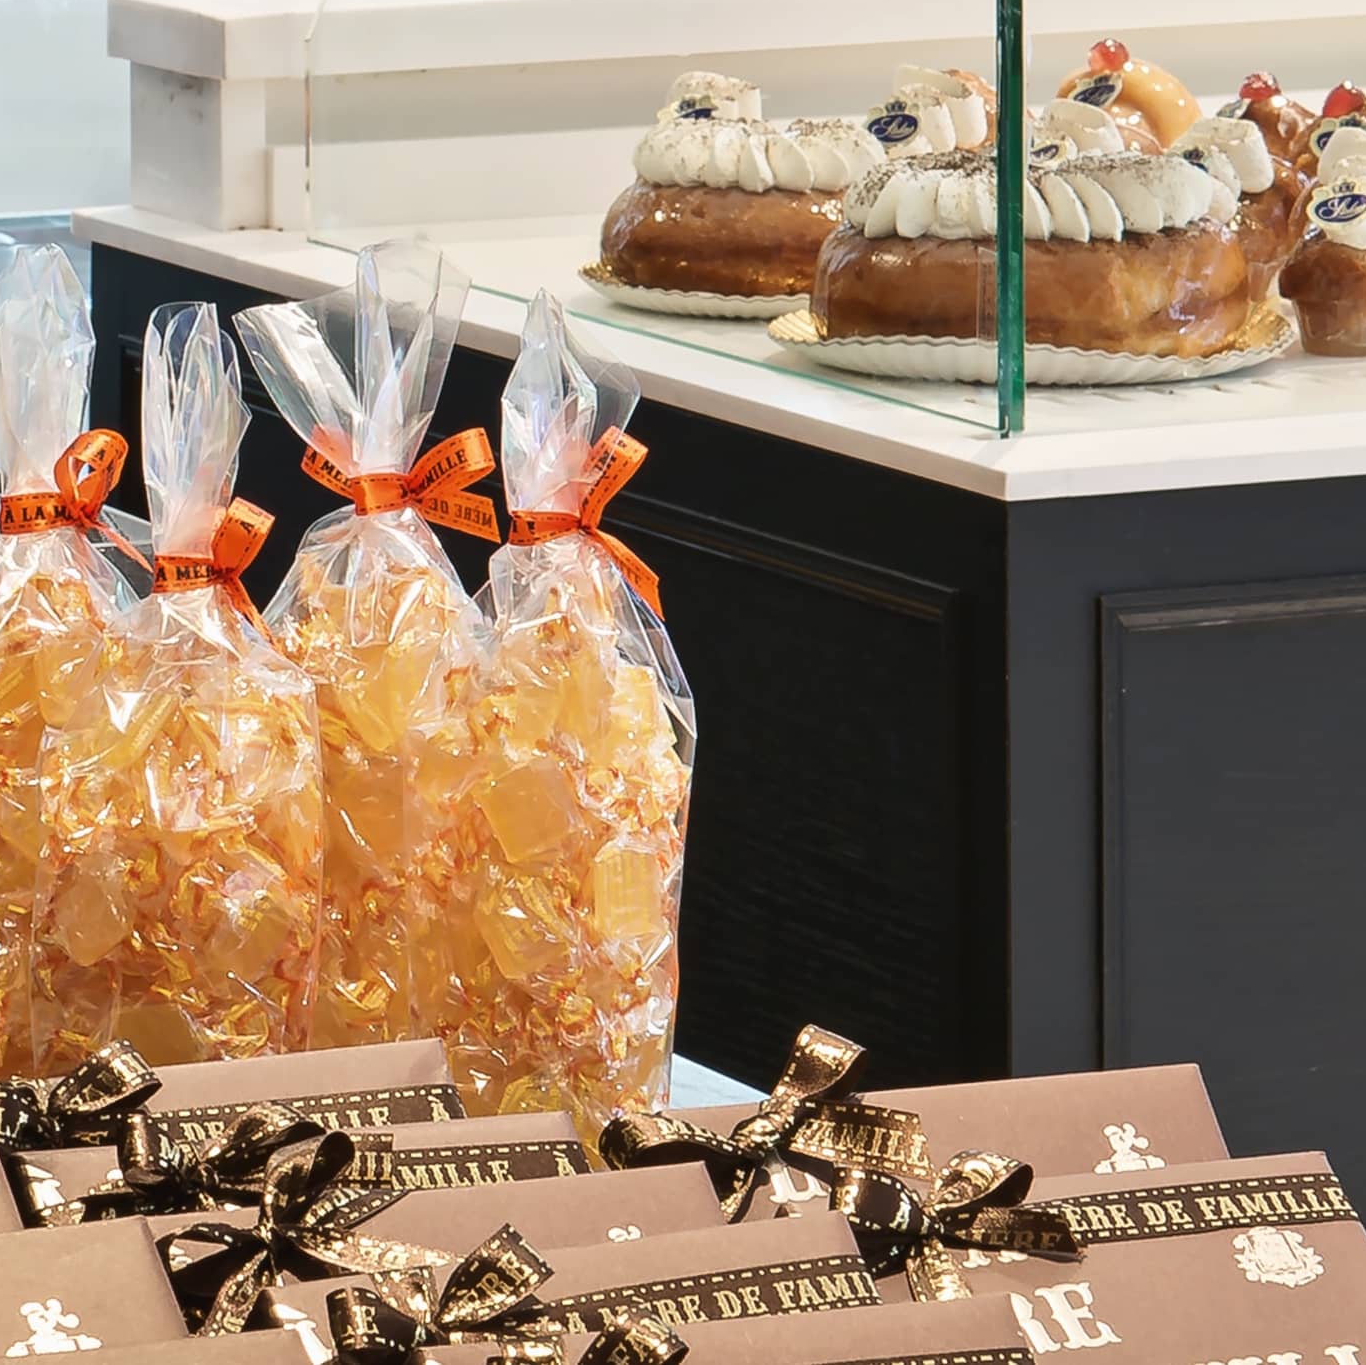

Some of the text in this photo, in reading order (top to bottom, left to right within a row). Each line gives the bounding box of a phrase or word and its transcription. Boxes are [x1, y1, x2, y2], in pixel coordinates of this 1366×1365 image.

[1139, 1199, 1192, 1227] DE
[1196, 1186, 1352, 1223] FAMILLE
[713, 1285, 769, 1317] DE
